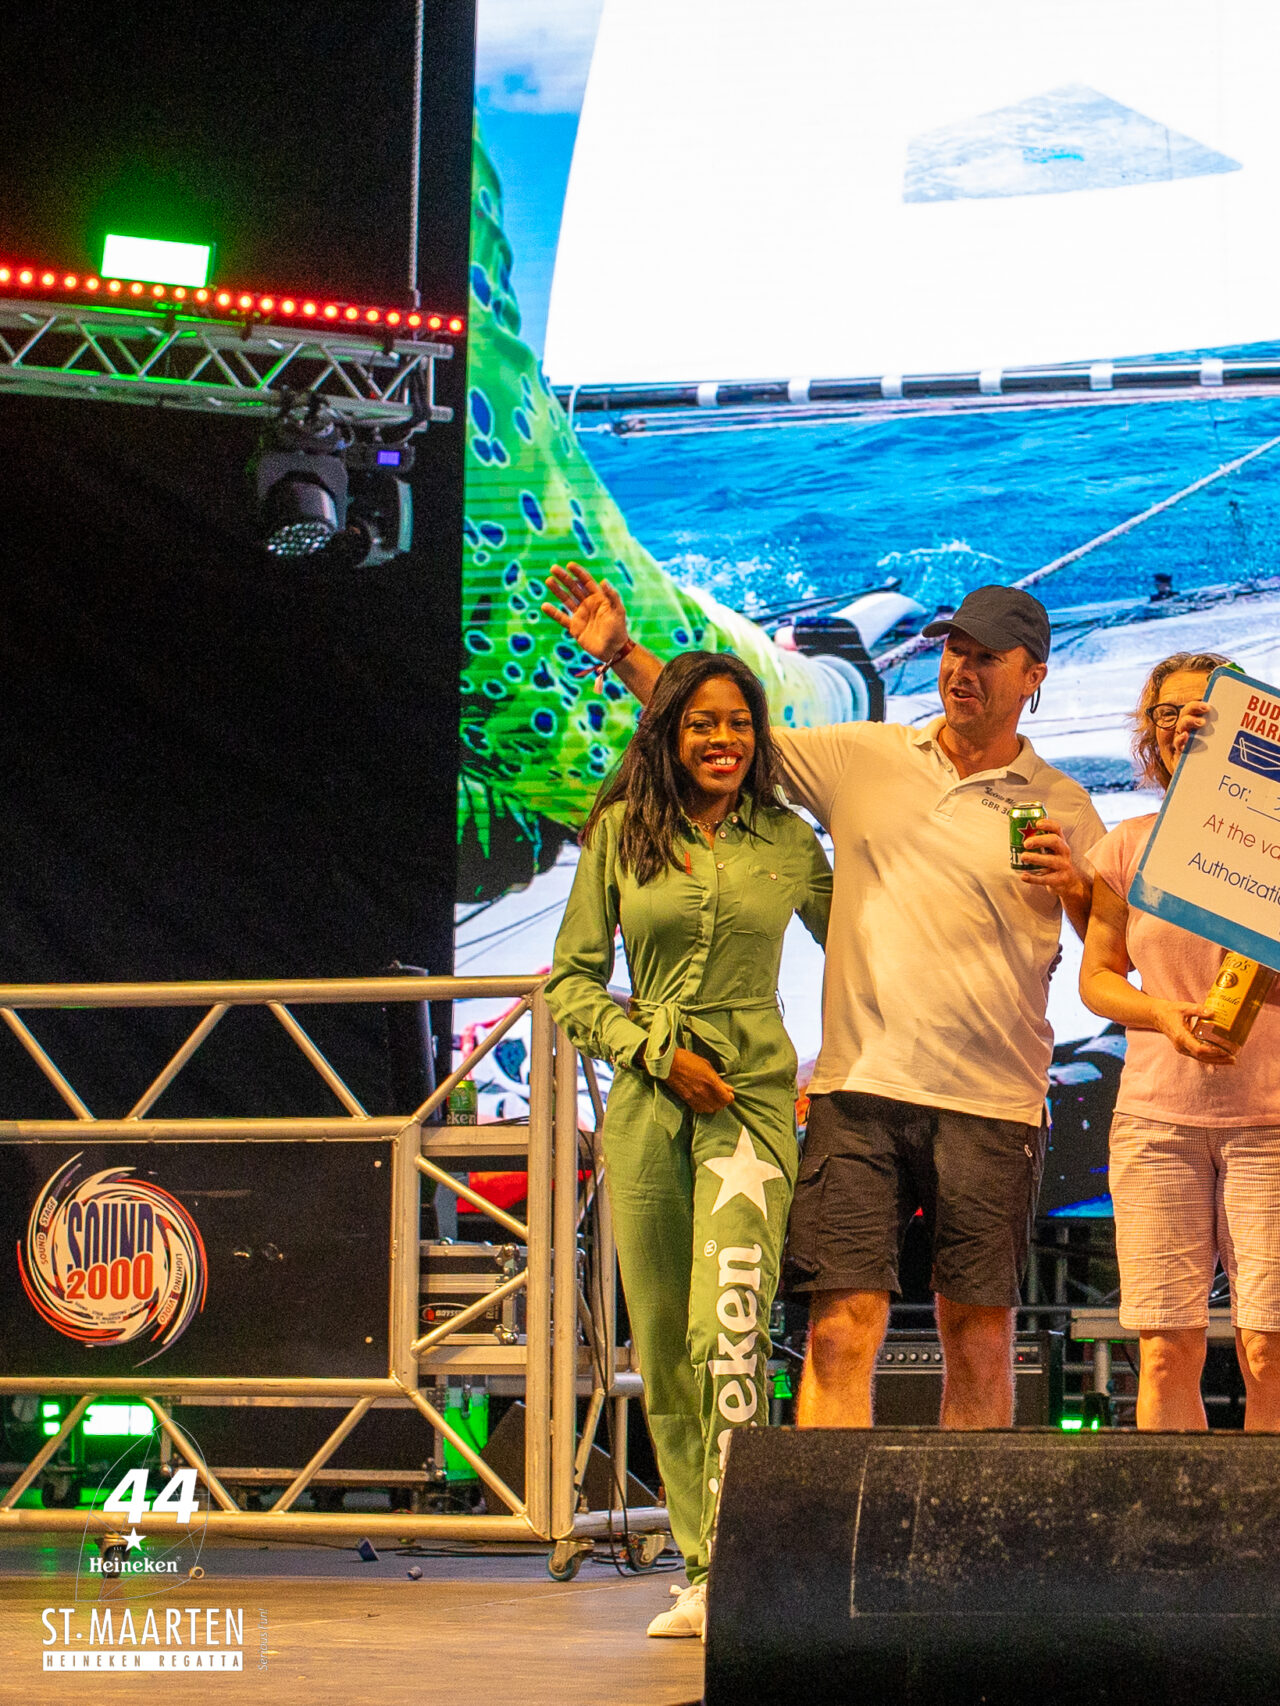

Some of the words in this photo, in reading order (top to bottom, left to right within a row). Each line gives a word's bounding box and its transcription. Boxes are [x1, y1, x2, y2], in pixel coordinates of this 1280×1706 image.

[1218, 775, 1252, 803] For:
[981, 798, 1001, 812] GBR
[1203, 814, 1223, 835] At
[1229, 821, 1257, 848] the
[41, 1198, 57, 1227] STAGE
[37, 1234, 48, 1265] SOUND
[66, 1201, 154, 1271] SOUND
[66, 1253, 154, 1301] 2000
[173, 1252, 184, 1292] LIGHTING
[159, 1299, 177, 1324] VIDEO
